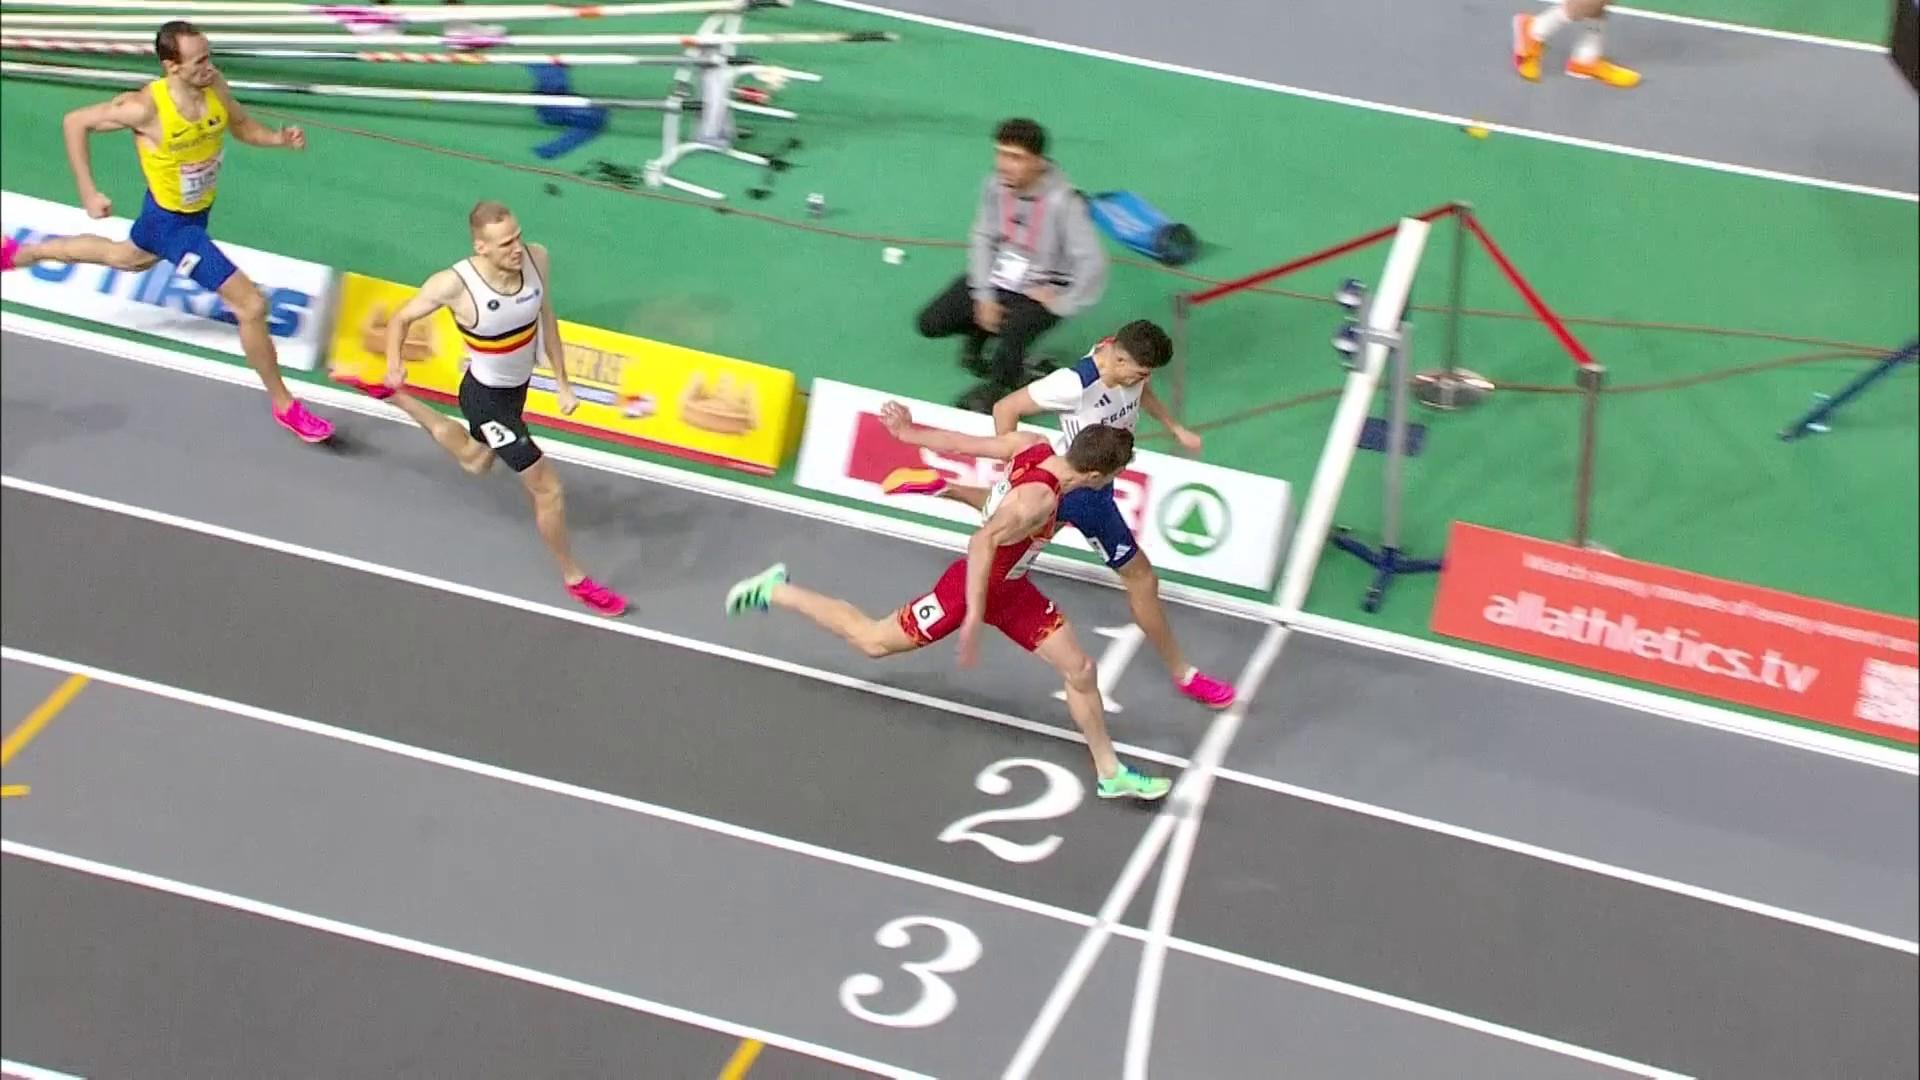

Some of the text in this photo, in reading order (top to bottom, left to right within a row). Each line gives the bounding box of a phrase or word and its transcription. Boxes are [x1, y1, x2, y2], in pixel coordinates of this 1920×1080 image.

[489, 424, 506, 443] 3
[919, 604, 936, 620] 6
[1483, 590, 1820, 694] allathletics.tv
[1050, 622, 1145, 714] 1
[937, 757, 1085, 863] 2
[839, 916, 983, 1028] 3
